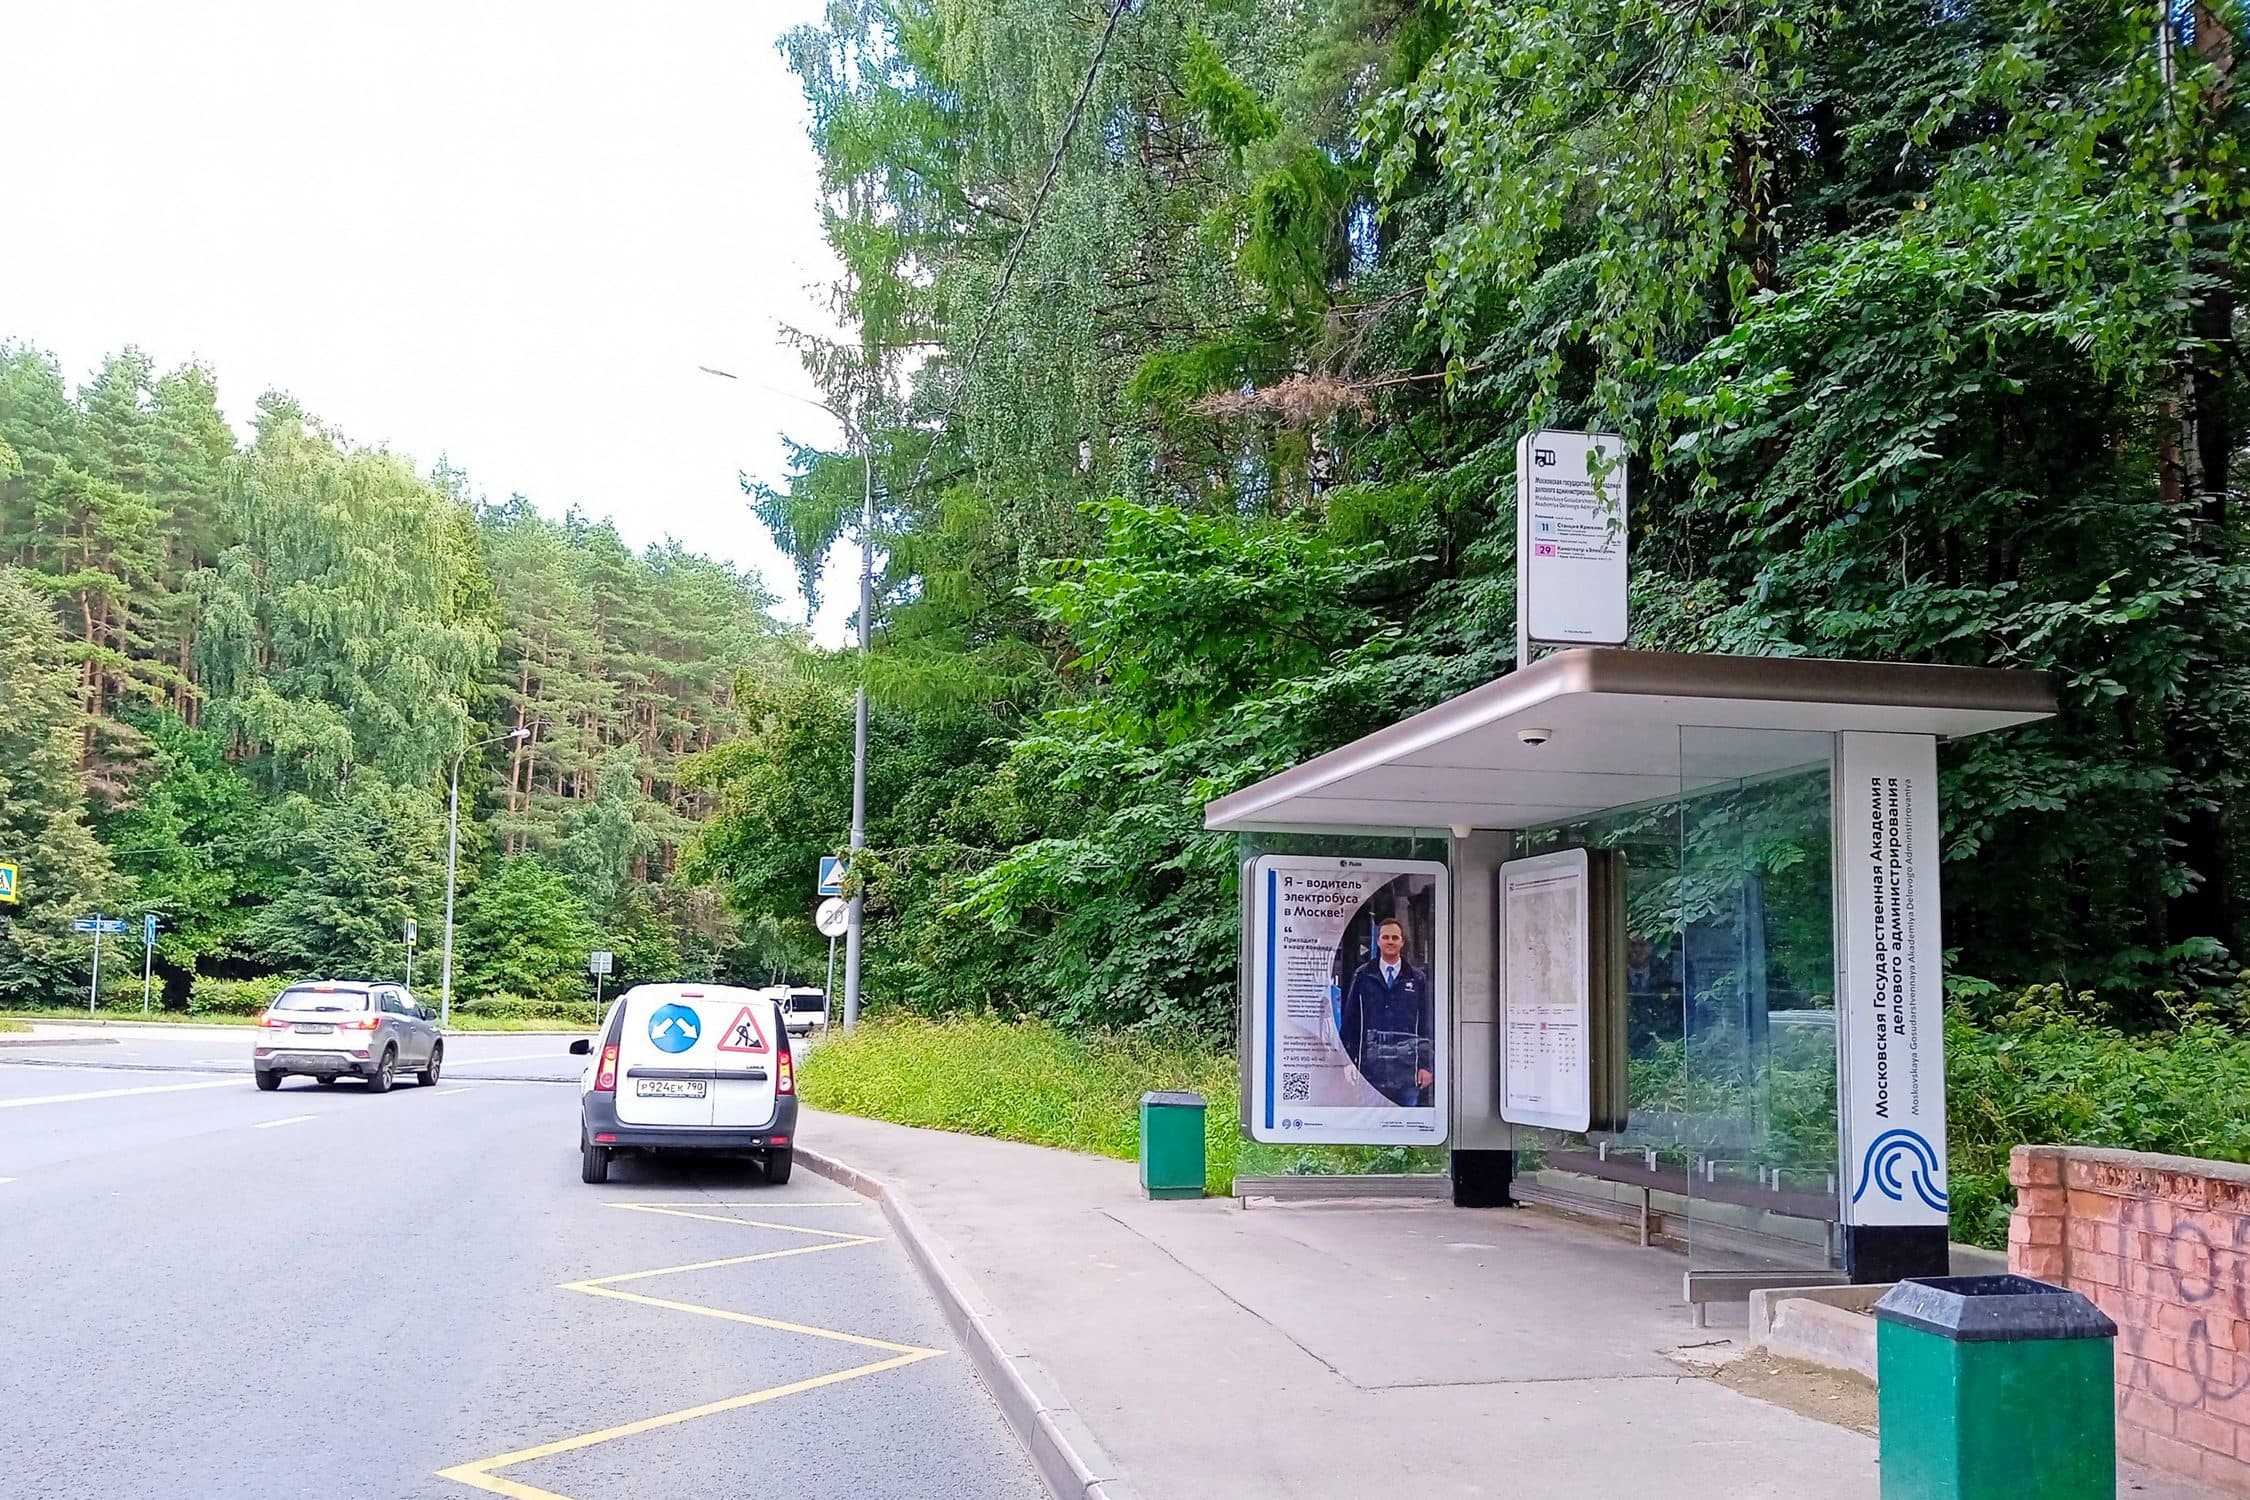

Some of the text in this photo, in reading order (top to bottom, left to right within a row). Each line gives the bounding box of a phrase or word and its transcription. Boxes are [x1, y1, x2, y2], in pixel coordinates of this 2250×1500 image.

[1542, 523, 1549, 531] 11
[1540, 546, 1551, 554] 29
[1284, 876, 1293, 887] Я
[1306, 879, 1362, 889] водитель
[1284, 892, 1358, 905] электробуса
[1284, 906, 1344, 918] в Москве!
[1888, 778, 1906, 1035] делового администрирования
[825, 910, 844, 925] 20
[1869, 777, 1889, 1119] Московская Государственная Академия
[1904, 778, 1920, 1116] Moskovskaya Gosudarstvennaya Akademiya Delovogo Administrirovaniya
[687, 1082, 703, 1091] 790
